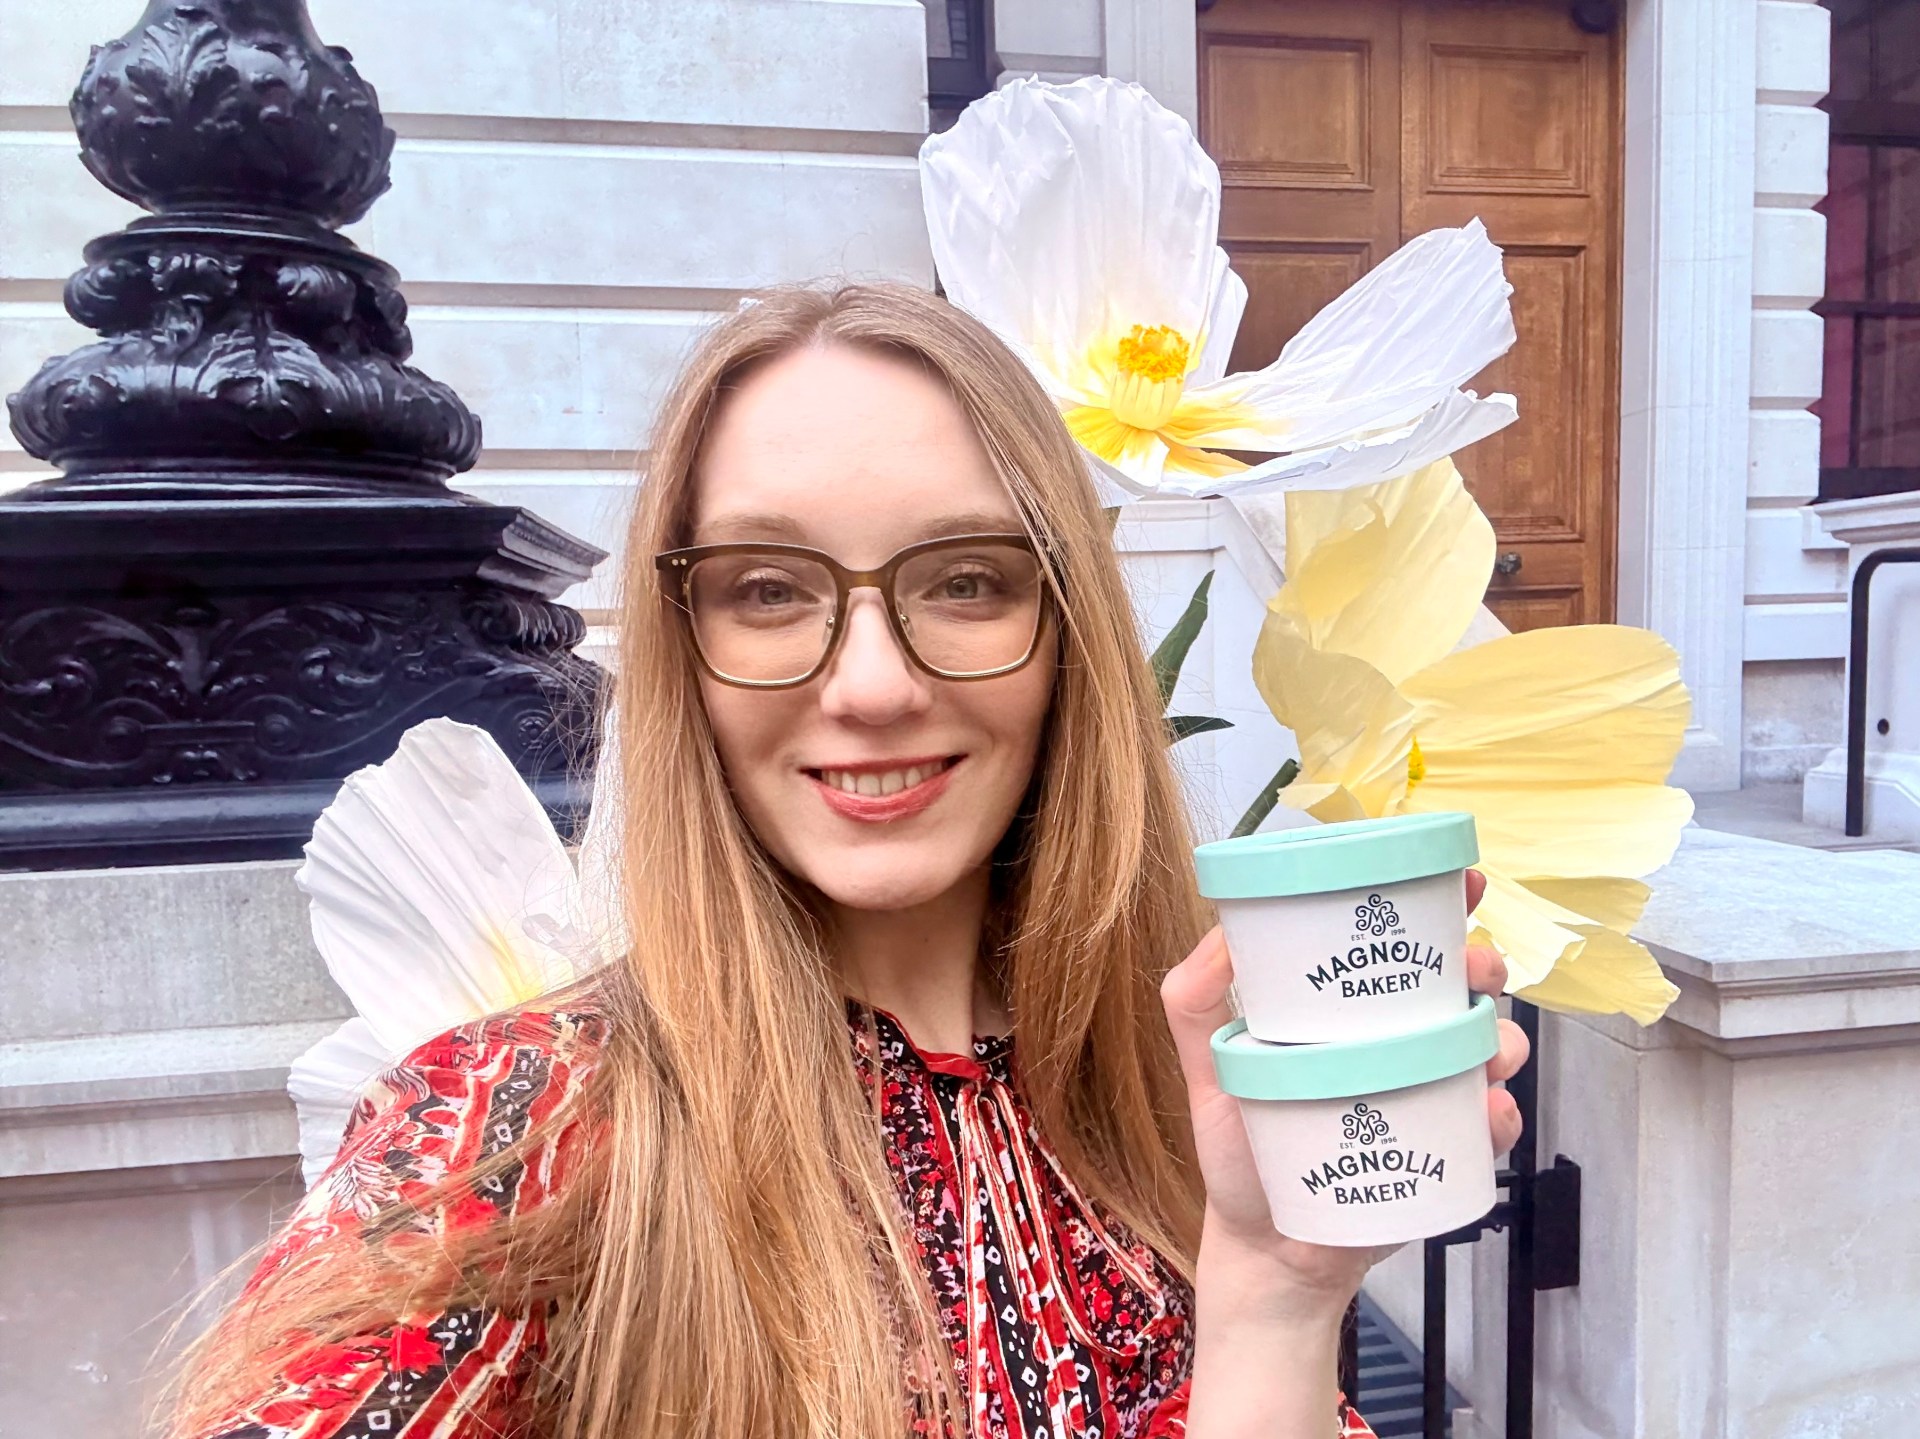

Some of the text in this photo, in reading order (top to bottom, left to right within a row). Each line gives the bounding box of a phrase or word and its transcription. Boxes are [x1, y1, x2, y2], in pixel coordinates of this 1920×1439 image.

[1391, 927, 1406, 936] 1996
[1305, 940, 1444, 992] MAGNOLIA
[1341, 969, 1422, 998] BAKERY
[1380, 1136, 1397, 1145] 1996
[1301, 1149, 1446, 1196] MAGNOLIA
[1334, 1177, 1419, 1205] BAKERY
